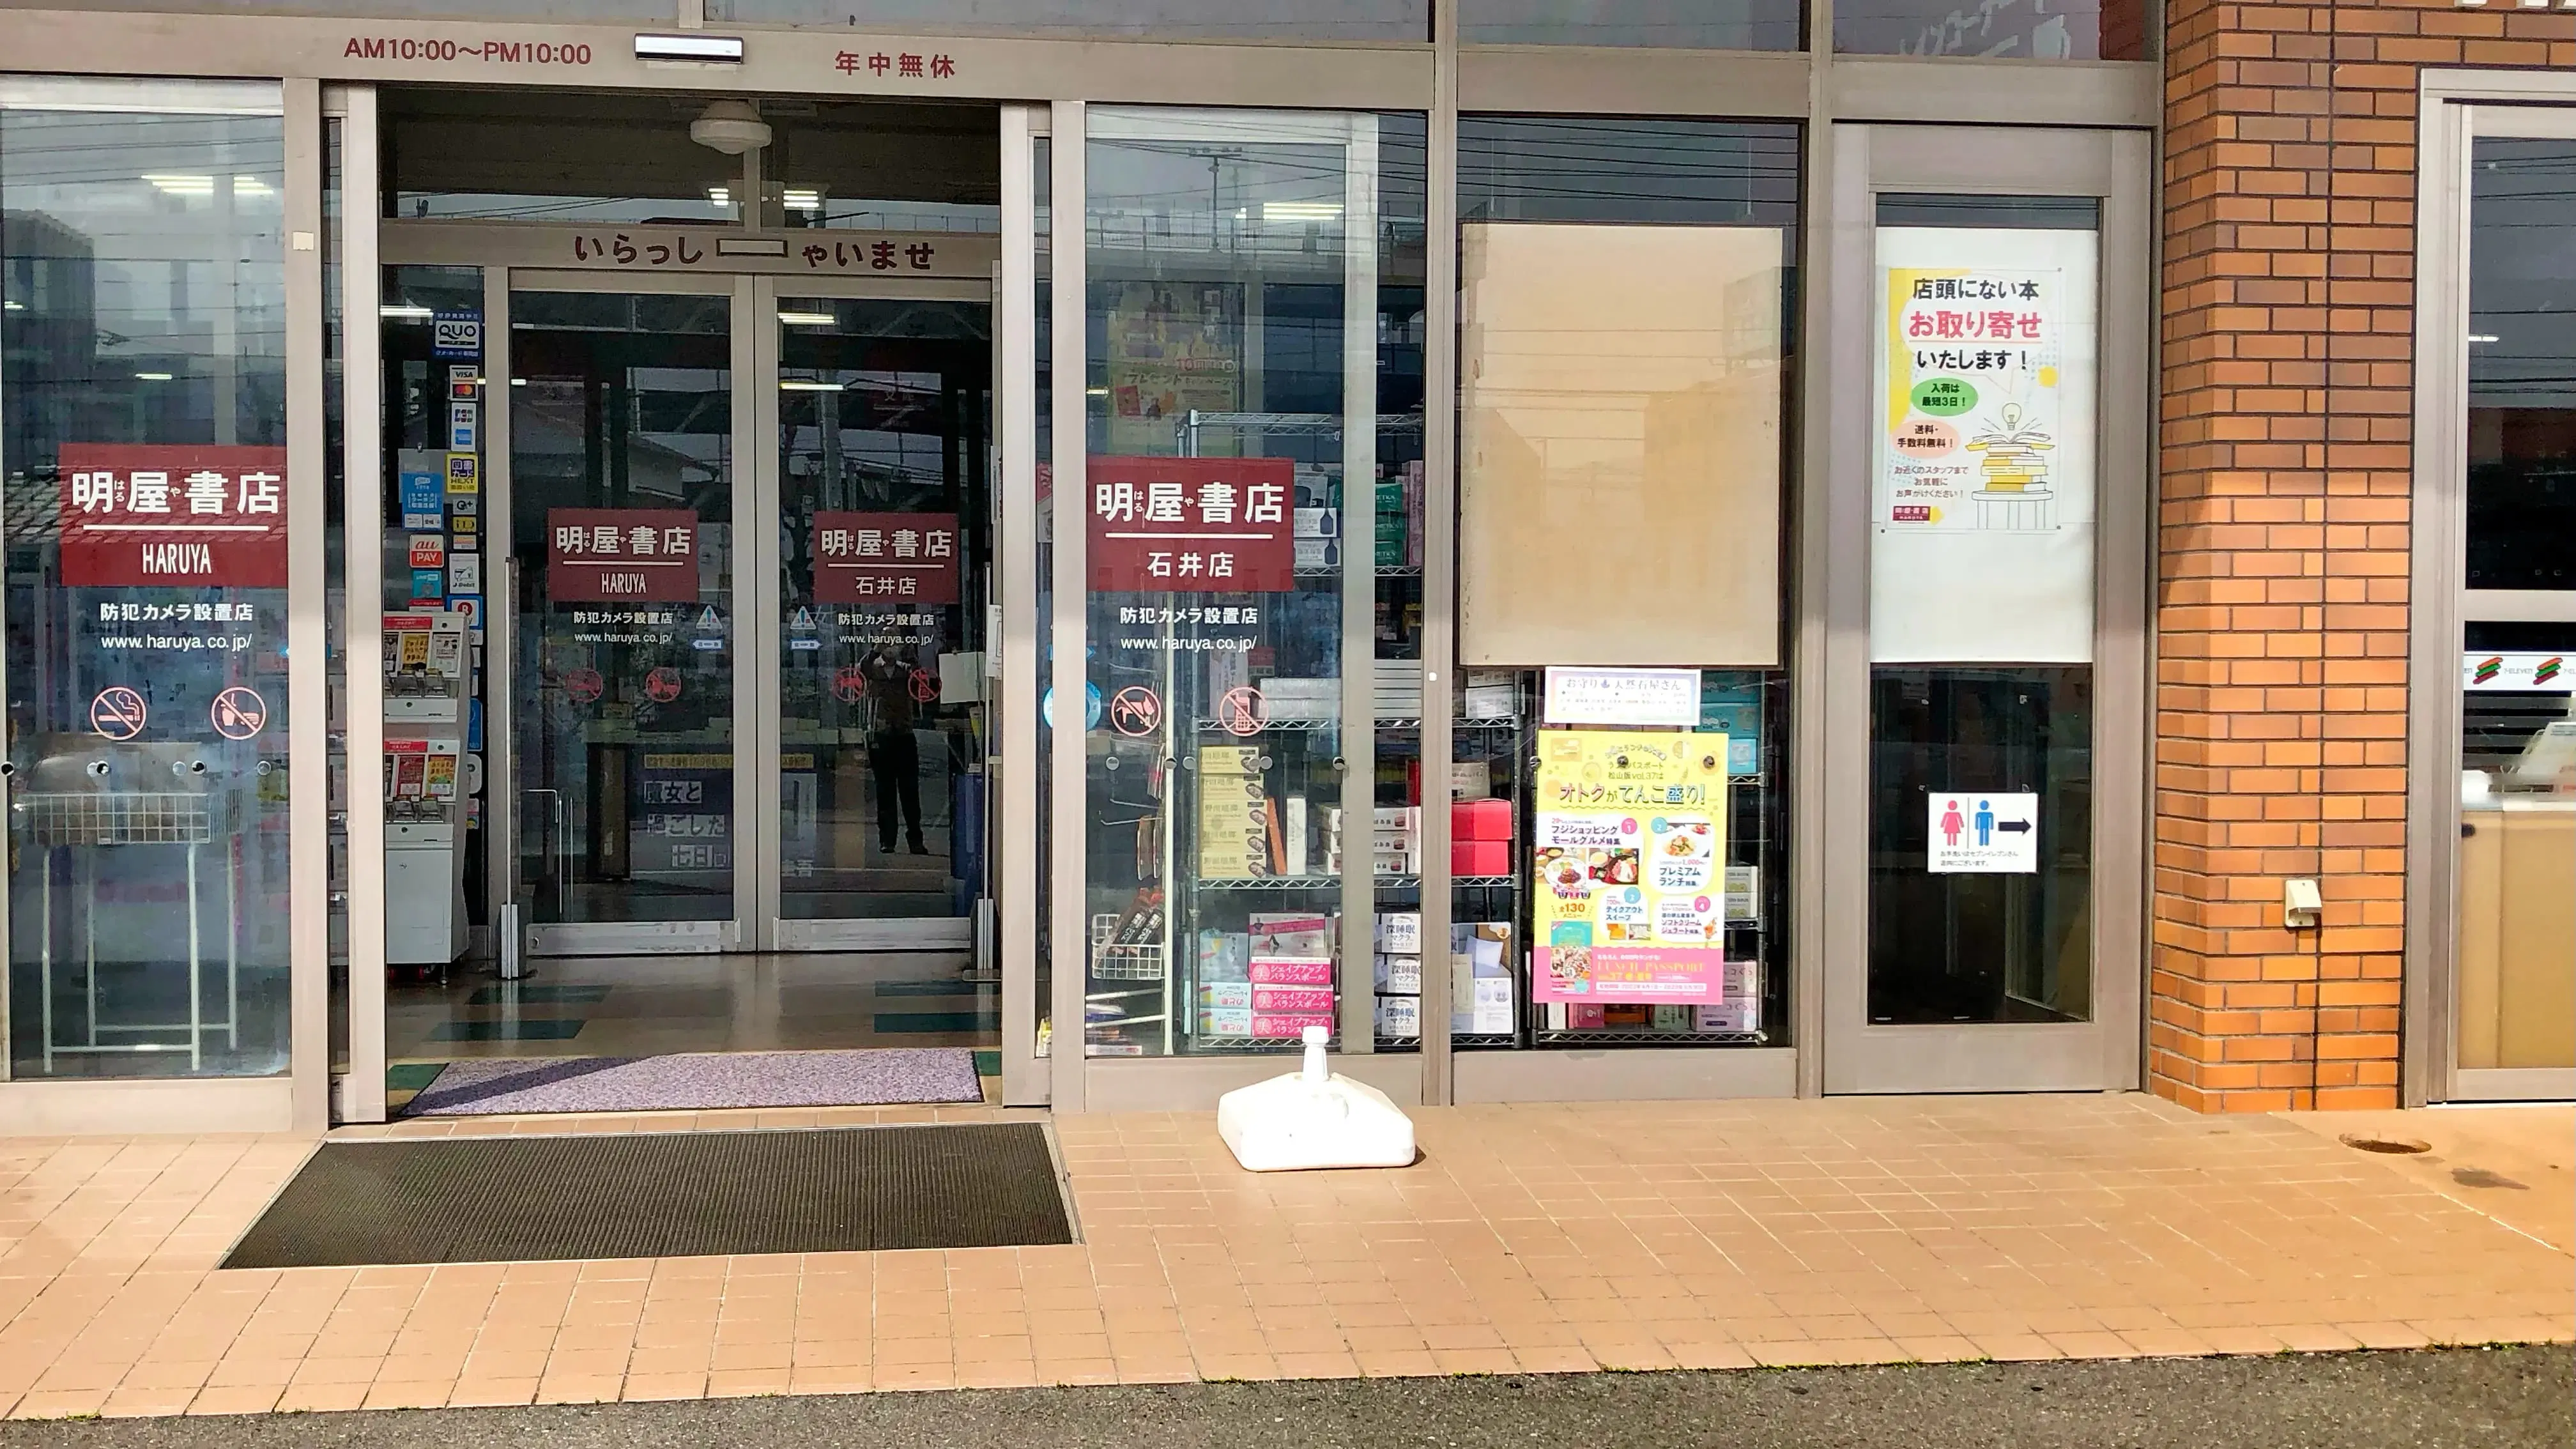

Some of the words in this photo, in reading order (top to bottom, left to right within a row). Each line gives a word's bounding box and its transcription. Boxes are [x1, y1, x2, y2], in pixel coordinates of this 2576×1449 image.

[834, 50, 956, 80] 年中無休
[1912, 277, 2040, 302] 店頭にない本
[438, 324, 477, 340] QUO
[1908, 310, 2043, 339] お取り寄せ
[1931, 383, 1960, 394] 入荷は
[415, 540, 440, 549] au
[142, 543, 212, 574] HARUYA
[417, 552, 438, 562] PAY
[1147, 552, 1234, 578] 石井店
[601, 572, 647, 594] HARUYA
[855, 576, 917, 596] 石井店
[100, 603, 254, 622] 防犯カメラ設置店
[573, 611, 673, 626] 防犯カメラ設置店
[838, 613, 935, 627] 防犯カメラ設置店
[1119, 607, 1259, 625] 防犯カメラ設置店
[100, 634, 252, 652] www.haruya.co.jp/
[574, 631, 673, 645] www.haruya.co.jp/
[838, 633, 934, 646] www.haruya.co.jp/
[1120, 635, 1257, 652] www.haruya.co.jp/
[1551, 825, 1620, 835] フジショッピング
[1551, 836, 1621, 845] モールグルメ特集
[1659, 867, 1701, 876] プレミアム
